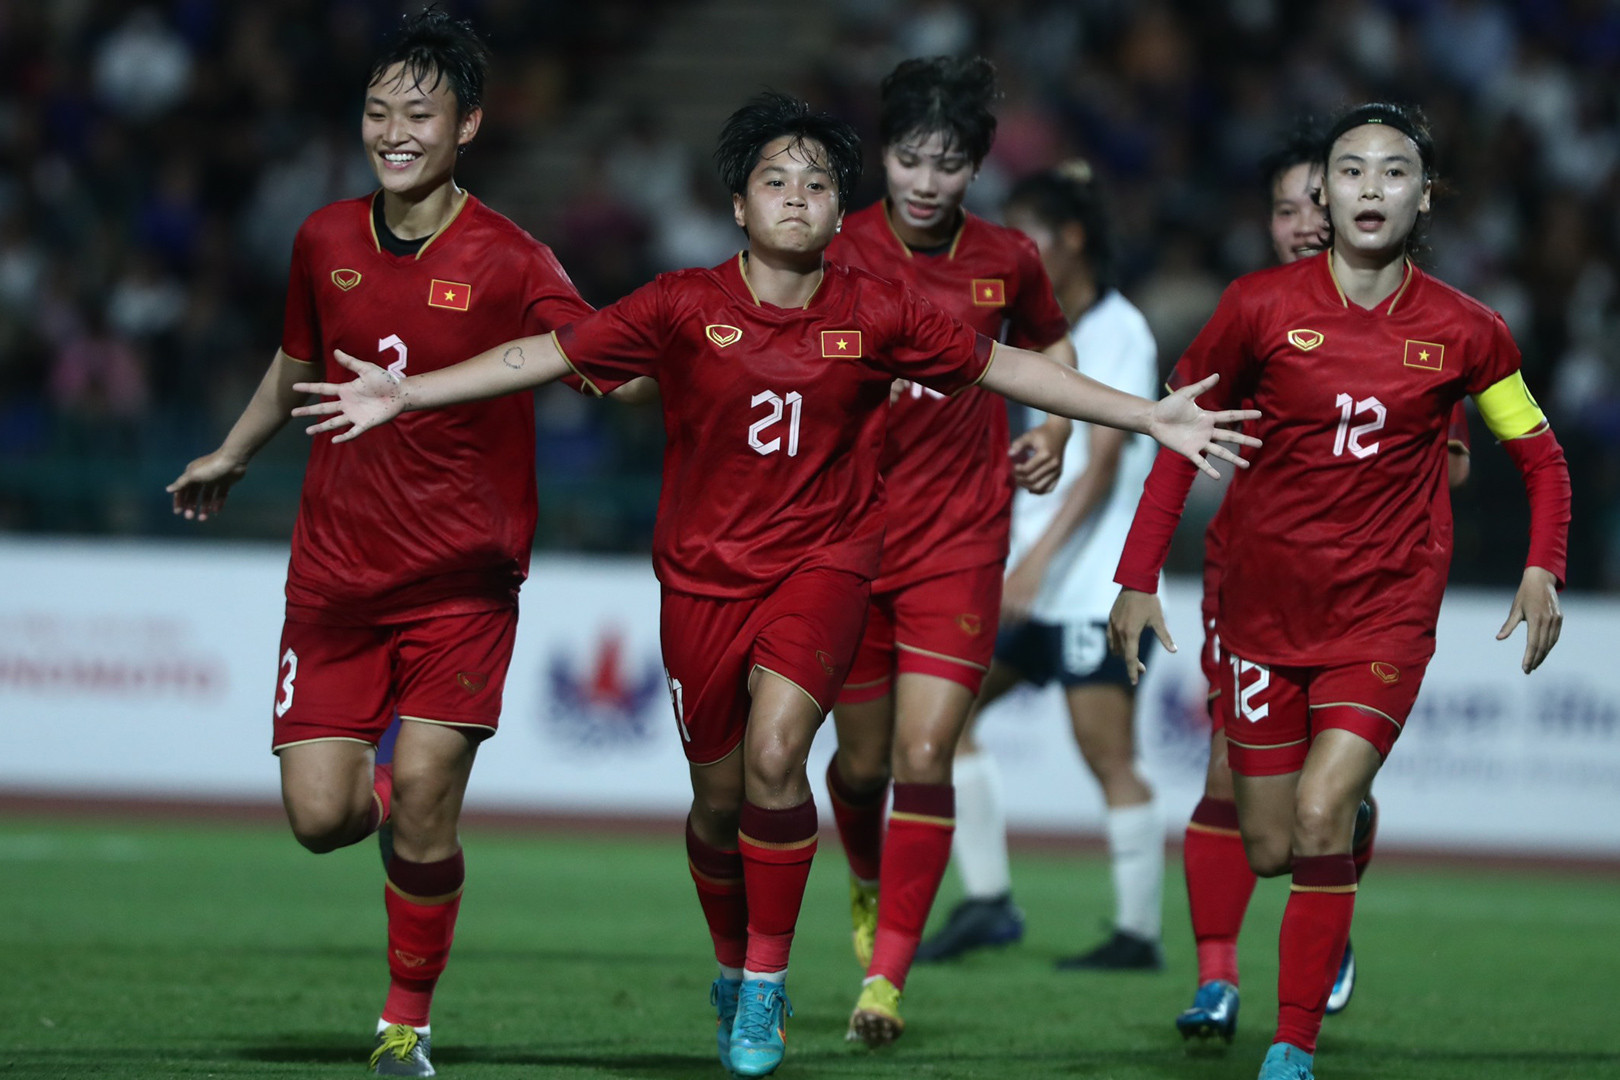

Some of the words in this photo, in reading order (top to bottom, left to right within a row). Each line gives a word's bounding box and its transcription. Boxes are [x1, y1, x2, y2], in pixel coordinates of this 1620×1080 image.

[748, 389, 803, 457] 21
[1333, 392, 1387, 459] 12
[276, 647, 299, 718] 3
[1230, 653, 1270, 723] 12
